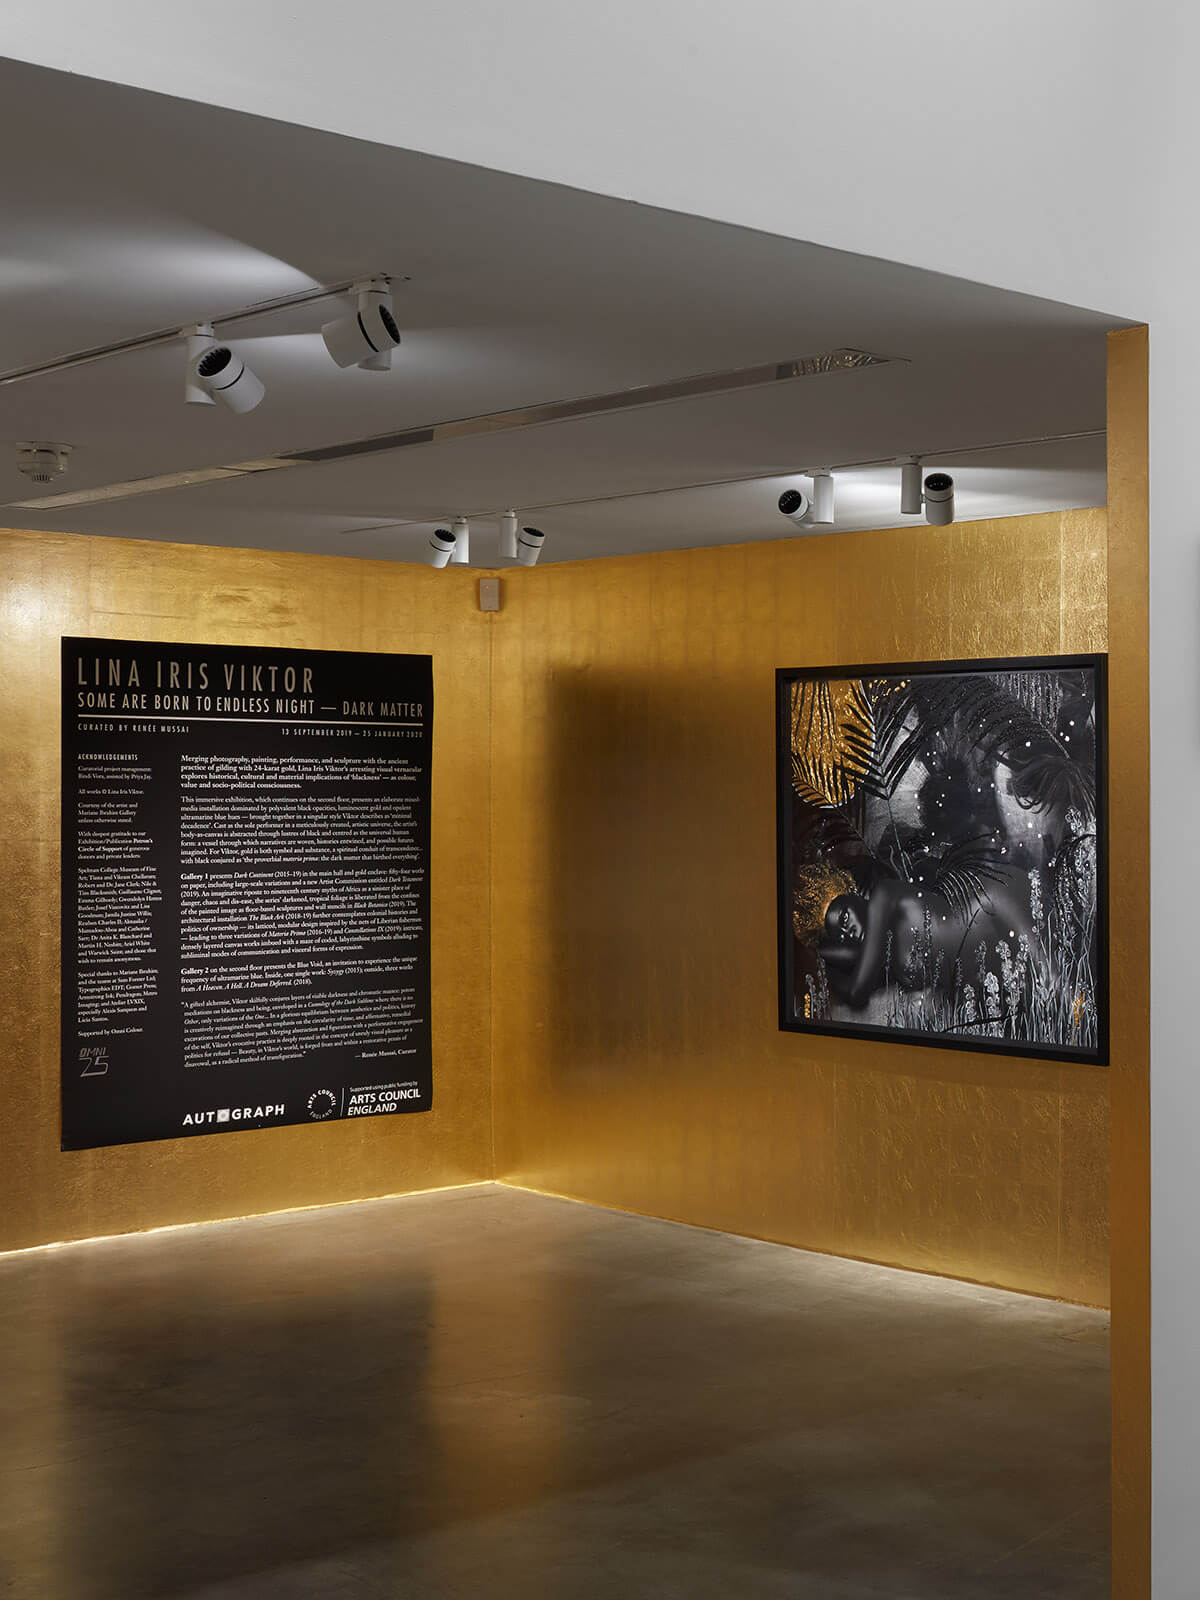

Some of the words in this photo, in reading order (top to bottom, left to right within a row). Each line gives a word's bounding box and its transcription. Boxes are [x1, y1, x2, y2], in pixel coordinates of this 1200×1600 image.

[78, 657, 140, 687] LINA
[157, 660, 209, 690] IRIS
[224, 664, 313, 694] VIKTOR
[78, 692, 116, 708] SOME
[122, 694, 147, 709] ARE
[154, 694, 189, 710] BORN
[196, 696, 212, 712] TO
[216, 696, 270, 713] ENDLESS
[276, 699, 315, 714] NIGHT
[343, 700, 374, 716] DARK
[380, 702, 424, 717] MATTER
[78, 723, 114, 732] CURATED
[118, 724, 128, 732] BY
[160, 726, 189, 734] MUSSAI
[282, 728, 289, 736] 13
[294, 728, 333, 736] SEPTEMBER
[336, 729, 352, 737] 2019
[363, 730, 370, 738] 25
[375, 730, 404, 738] JANUARY
[78, 753, 138, 761] ACKNOWLEDGEMENTS
[180, 754, 209, 764] Merging
[209, 755, 250, 765] photography,
[251, 756, 279, 765] painting,
[279, 756, 321, 765] performance,
[334, 757, 362, 766] sculpture
[180, 764, 206, 773] practice
[215, 764, 238, 773] gilding
[280, 765, 297, 774] gold,
[349, 766, 376, 775] arresting
[180, 772, 208, 781] explores
[305, 773, 342, 782] implications
[212, 781, 256, 790] socio-political
[80, 1047, 106, 1057] OMNI
[79, 1056, 110, 1078] 25
[306, 1093, 317, 1109] ARTS
[318, 1089, 337, 1106] COUNCIL
[349, 1092, 376, 1105] ARTS
[378, 1088, 421, 1102] COUNCIL
[347, 1102, 397, 1116] ENGLAND
